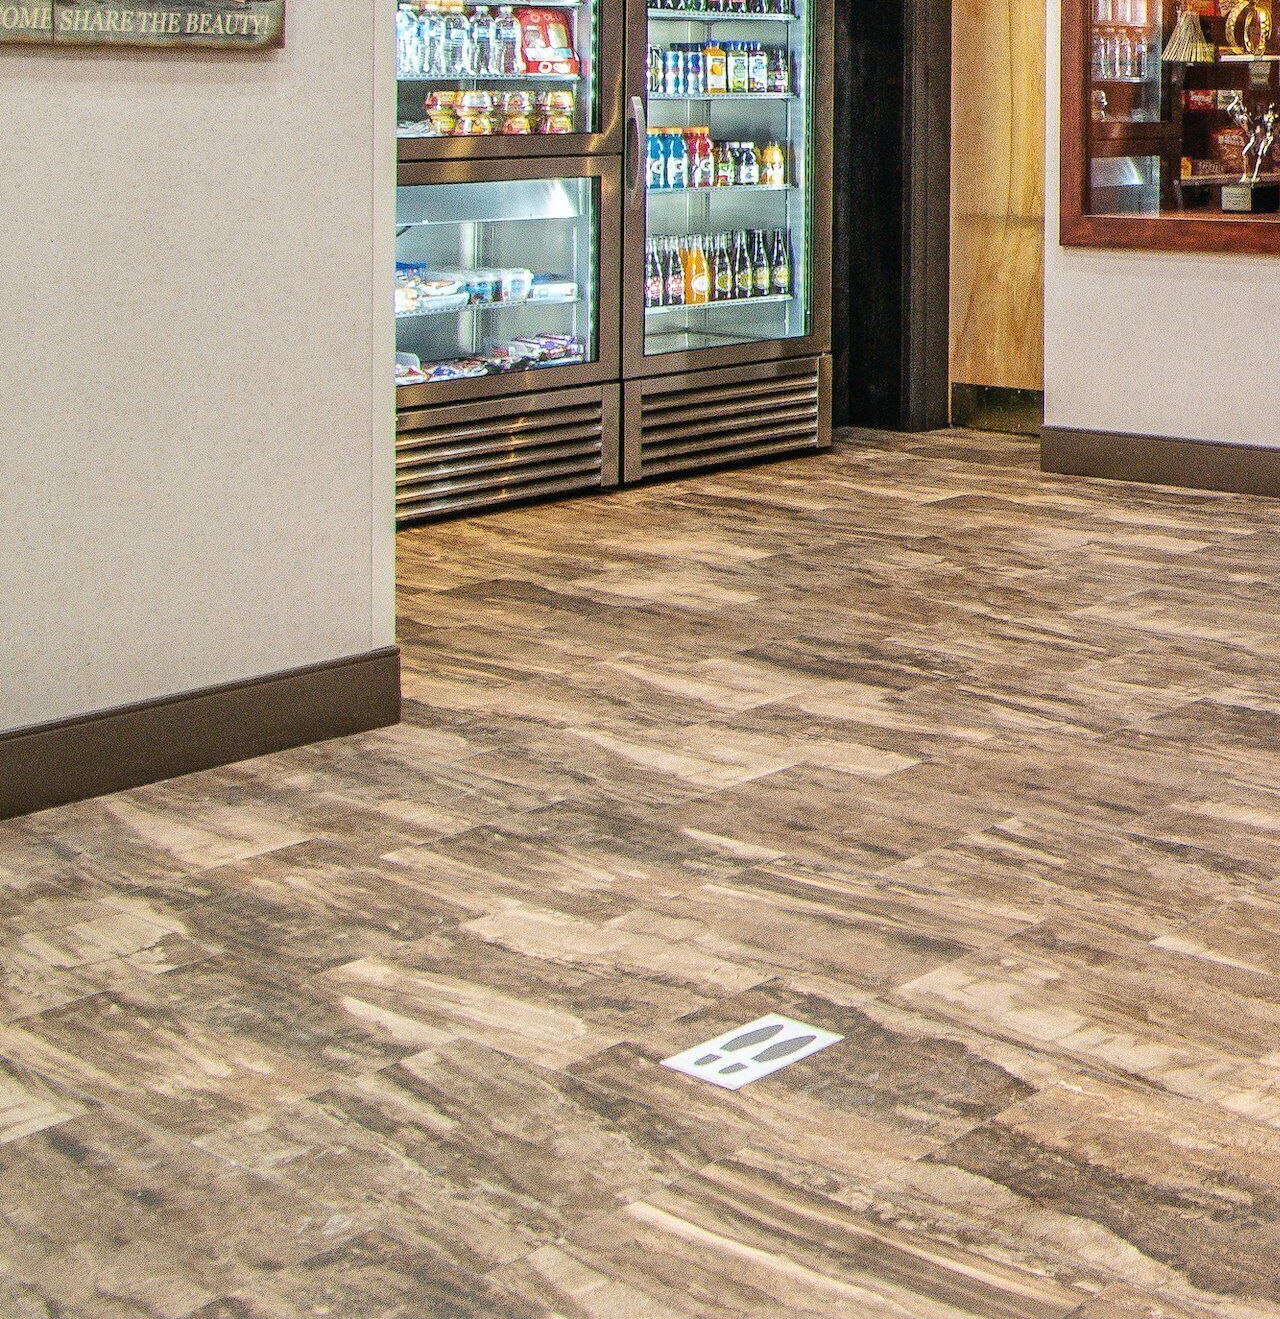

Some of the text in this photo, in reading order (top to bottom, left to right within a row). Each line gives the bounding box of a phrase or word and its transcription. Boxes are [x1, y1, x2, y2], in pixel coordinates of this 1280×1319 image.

[0, 7, 270, 36] OME SHARE THE BEAUTY!
